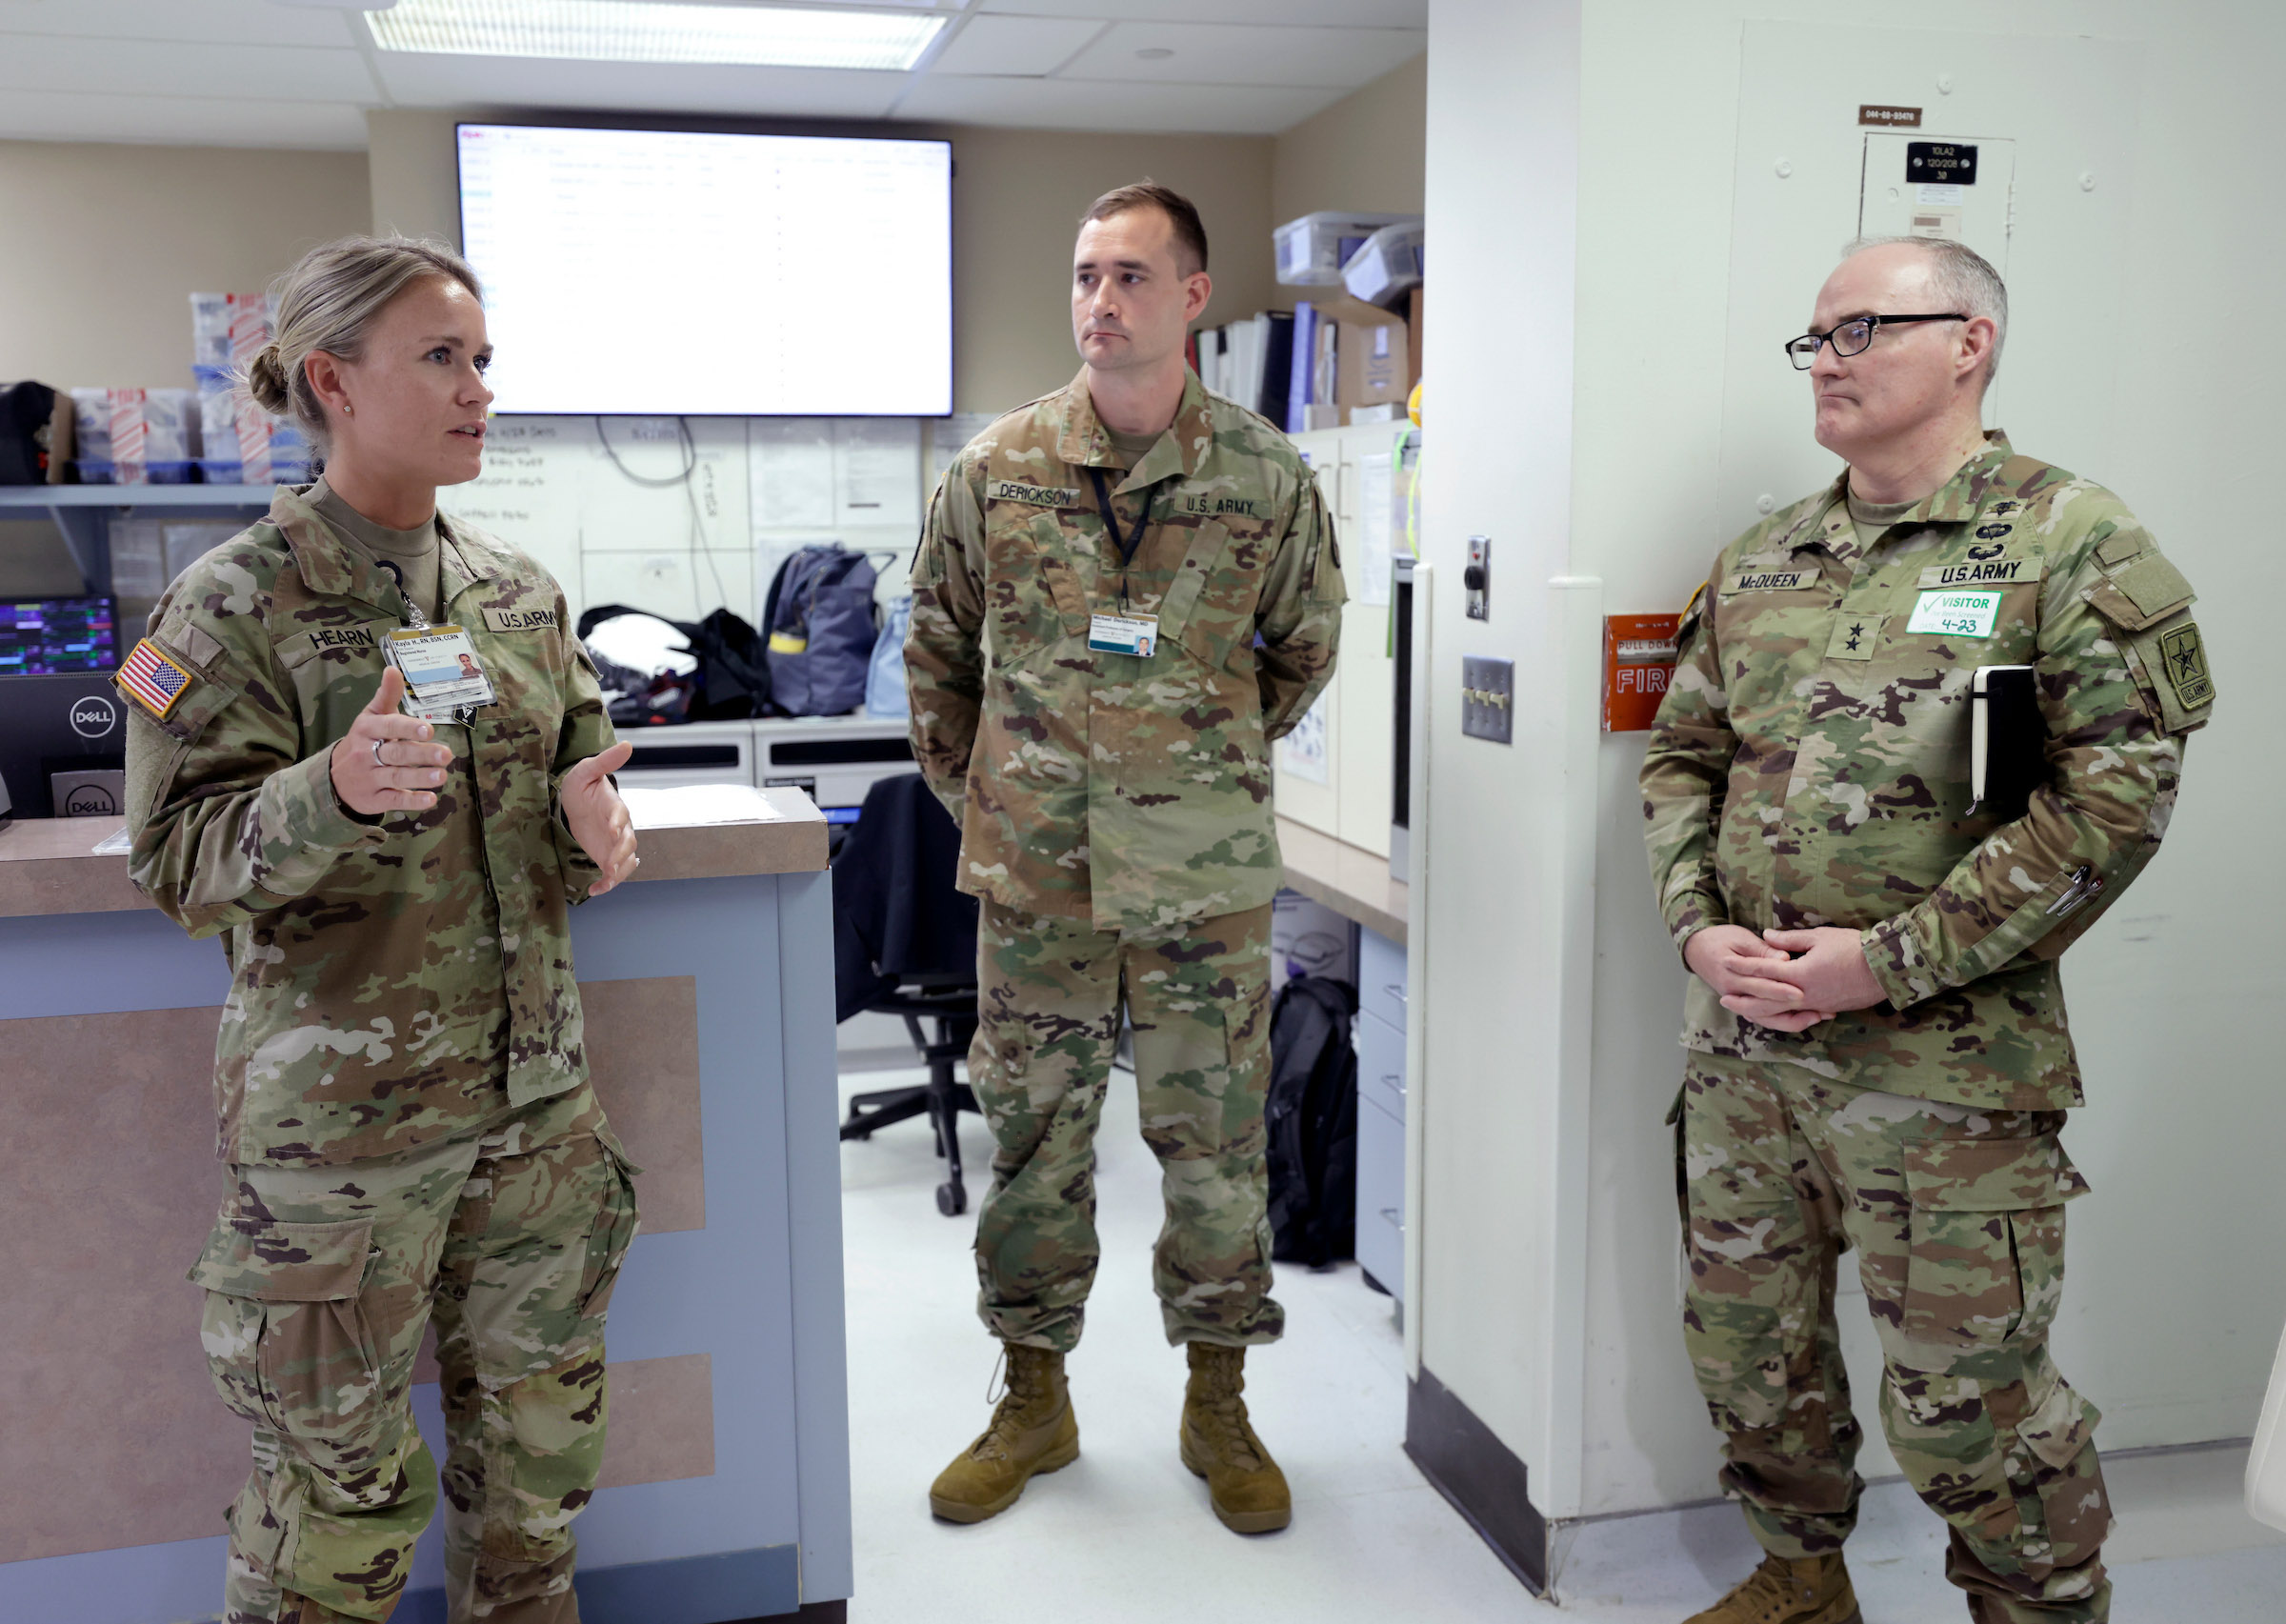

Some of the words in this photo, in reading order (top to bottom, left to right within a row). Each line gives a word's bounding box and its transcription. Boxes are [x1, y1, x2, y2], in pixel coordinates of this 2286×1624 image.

[999, 484, 1071, 505] DERICKSON
[1187, 496, 1211, 513] U.S.
[1216, 499, 1253, 514] ARMY
[1737, 573, 1800, 590] McQUEEN
[1942, 597, 1990, 609] VISITOR
[1942, 619, 1976, 632] 4-23
[309, 628, 374, 650] HEARN
[431, 635, 444, 644] BSN,
[1618, 640, 1643, 650] PULL
[75, 712, 111, 723] DELL
[71, 801, 110, 812] DELL
